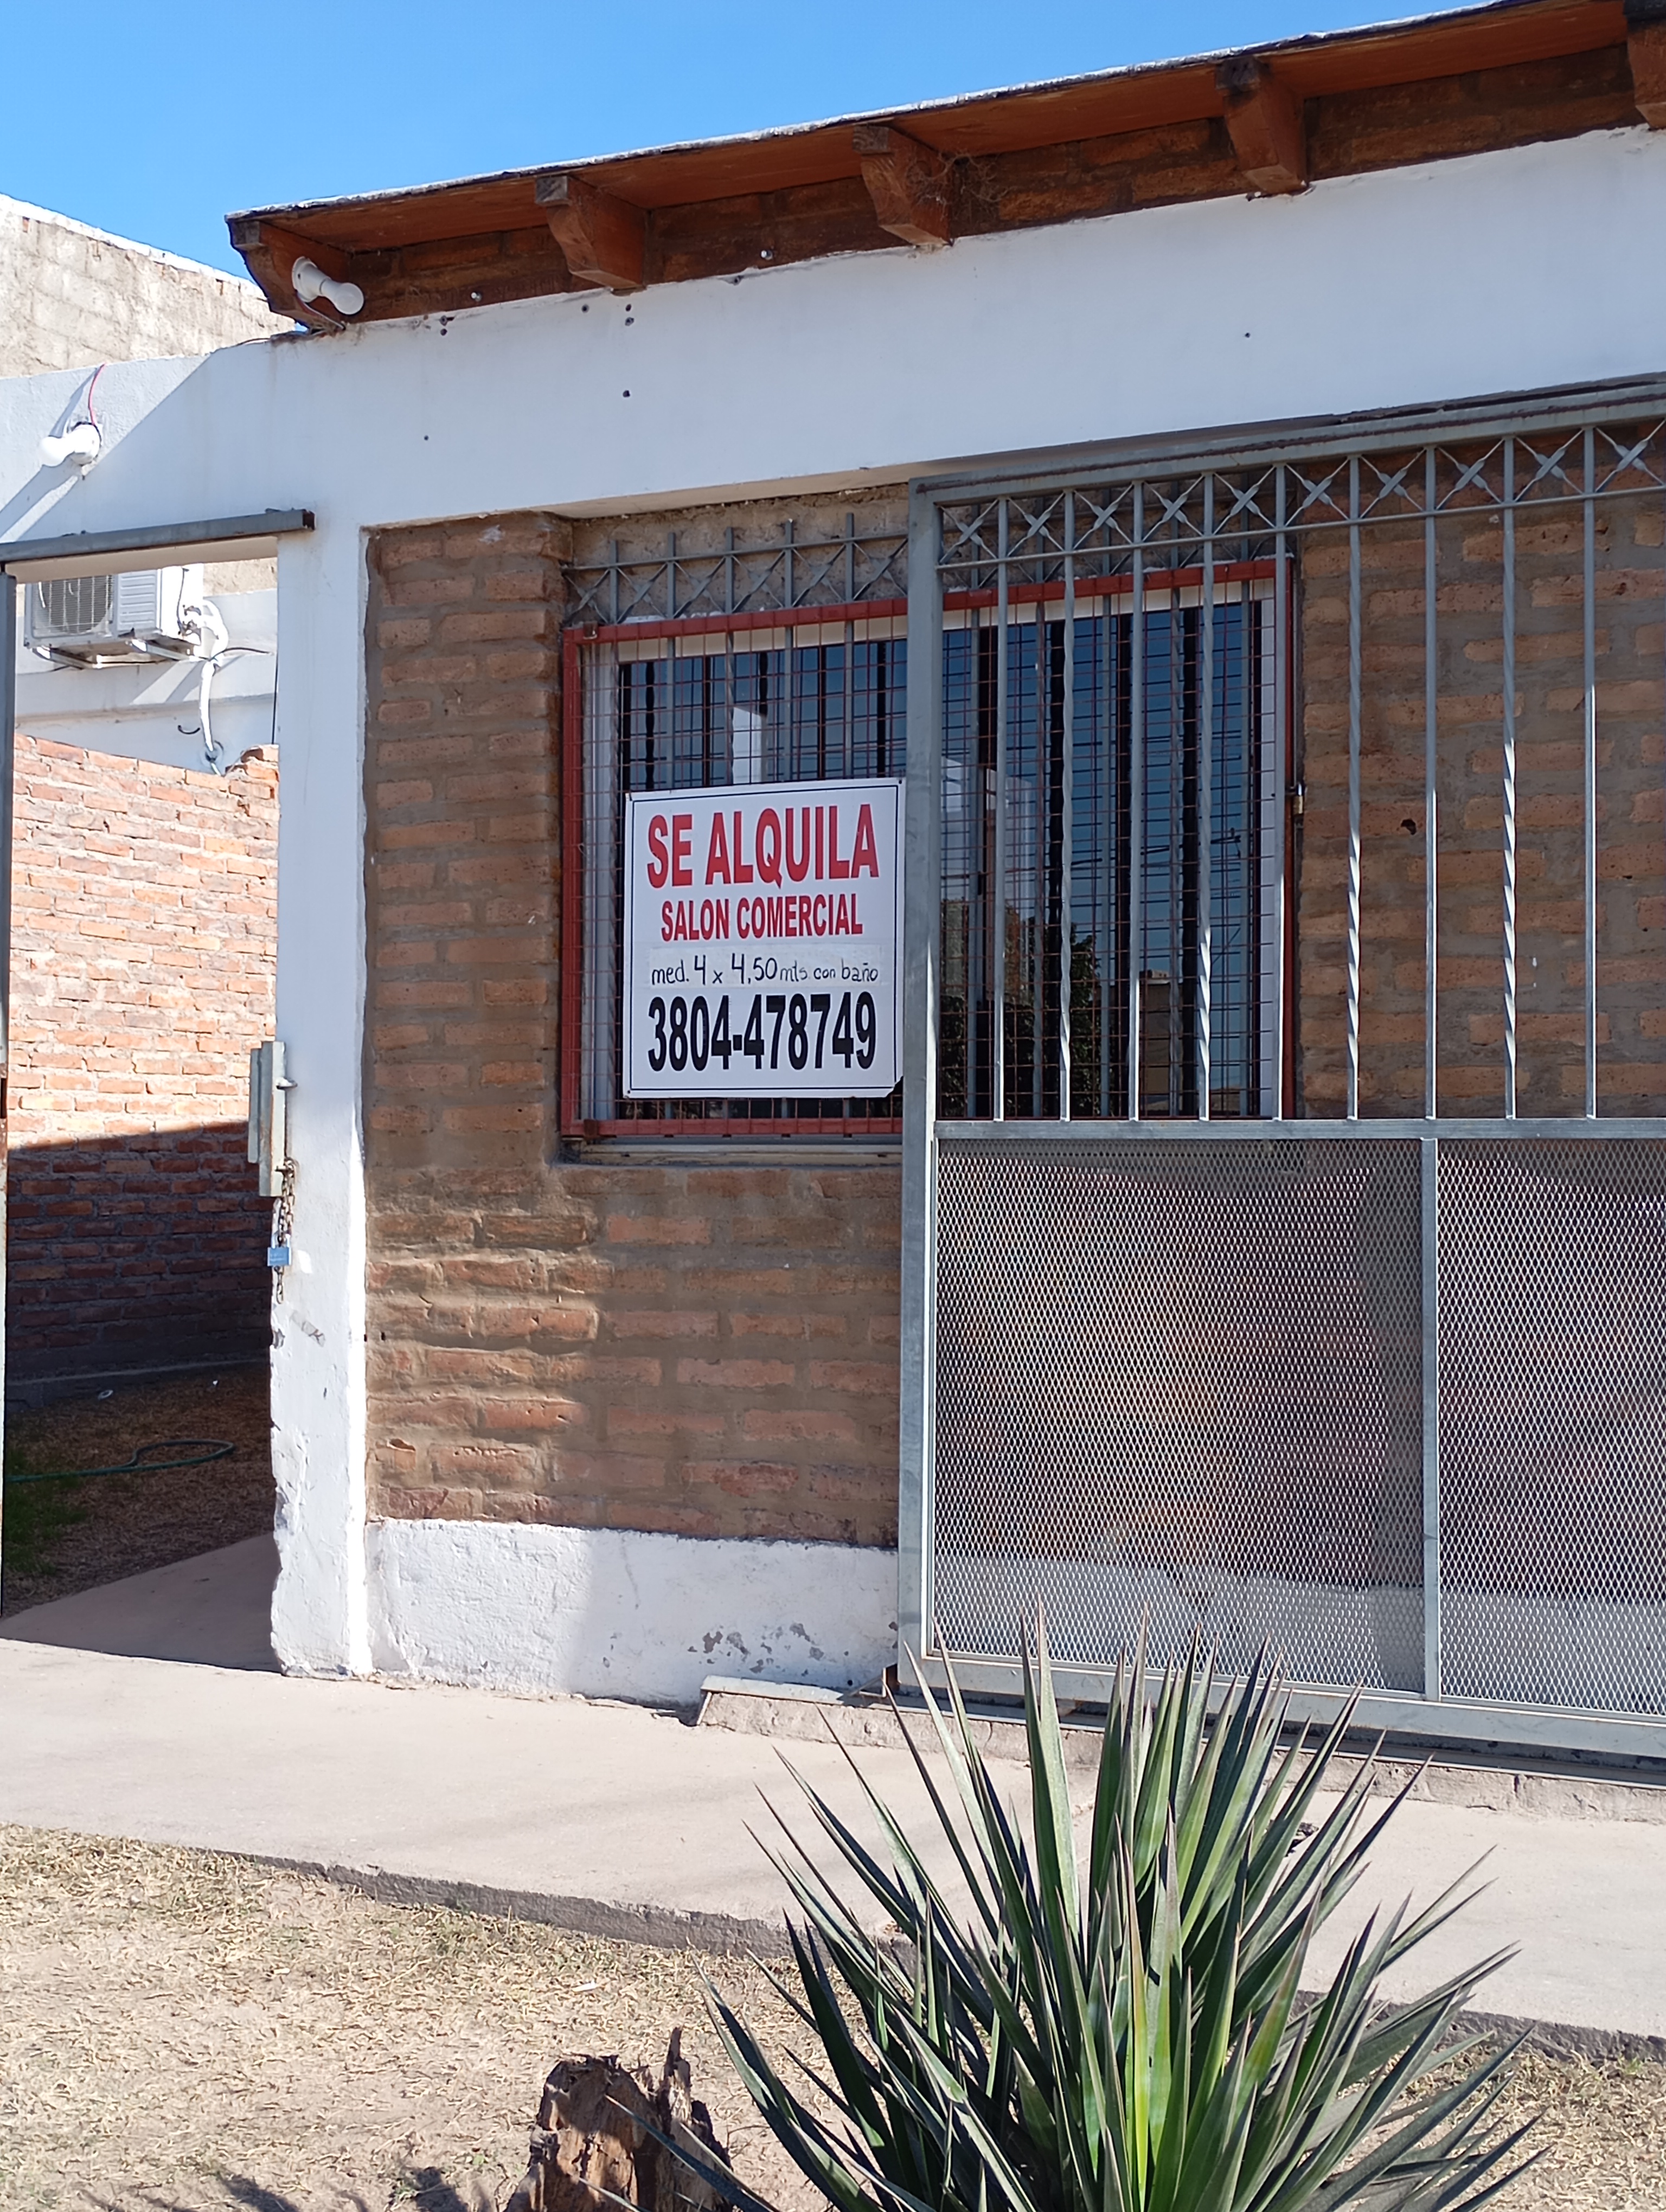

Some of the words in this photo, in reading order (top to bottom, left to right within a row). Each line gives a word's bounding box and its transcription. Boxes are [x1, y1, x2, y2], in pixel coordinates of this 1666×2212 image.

[647, 814, 693, 889] SE
[705, 803, 879, 889] ALQUILA
[661, 898, 729, 942] SALON
[737, 893, 863, 940] COMERCIAL
[652, 959, 689, 986] med.
[694, 954, 706, 986] 4
[780, 960, 808, 982] mts
[813, 967, 836, 980] con
[841, 957, 879, 982] baño
[648, 992, 876, 1072] 3804-478749
